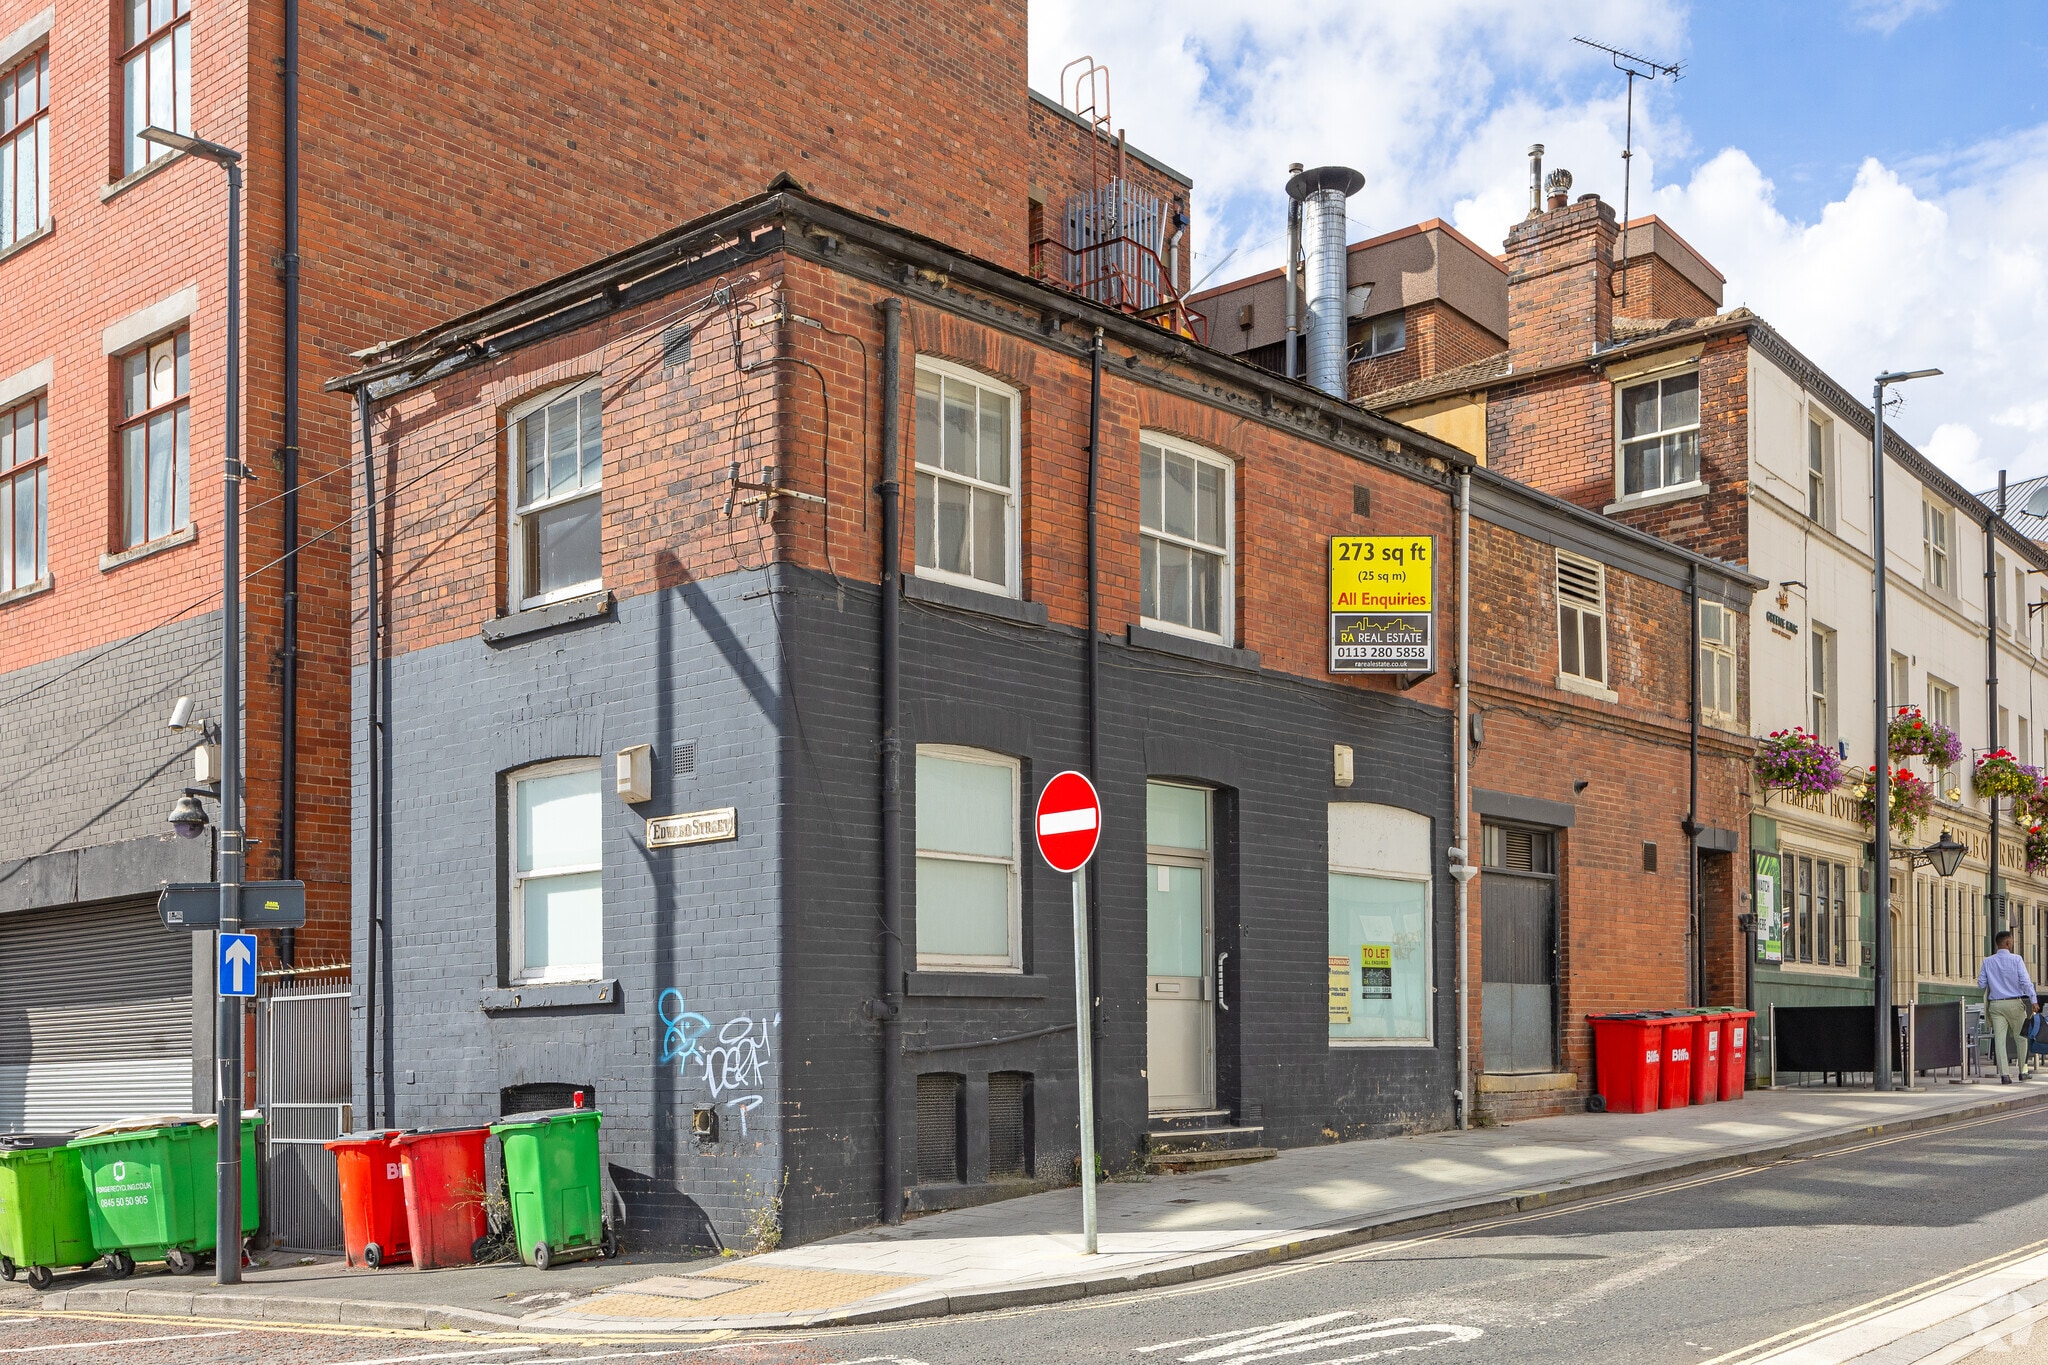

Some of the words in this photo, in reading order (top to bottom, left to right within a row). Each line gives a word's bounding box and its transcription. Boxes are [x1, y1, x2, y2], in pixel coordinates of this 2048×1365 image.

[1339, 543, 1375, 561] 273
[1382, 548, 1403, 566] sq
[1410, 543, 1426, 561] ft
[1358, 571, 1374, 583] (25
[1377, 573, 1389, 583] sq
[1392, 571, 1406, 583] m)
[1337, 592, 1357, 606] All
[1361, 592, 1426, 609] Enquiries
[1341, 633, 1354, 643] RA
[1358, 633, 1383, 643] REAL
[1386, 633, 1422, 643] ESTATE
[1337, 647, 1367, 658] 0113
[1370, 647, 1393, 658] 280
[1396, 647, 1425, 658] 5858
[1830, 792, 1860, 822] HOTEL
[1951, 827, 2023, 870] ELBORNE
[1363, 948, 1374, 958] TO
[1375, 948, 1390, 959] LET
[101, 1198, 115, 1208] 0845
[116, 1197, 124, 1207] 50
[125, 1196, 134, 1206] 50
[135, 1195, 148, 1205] 905
